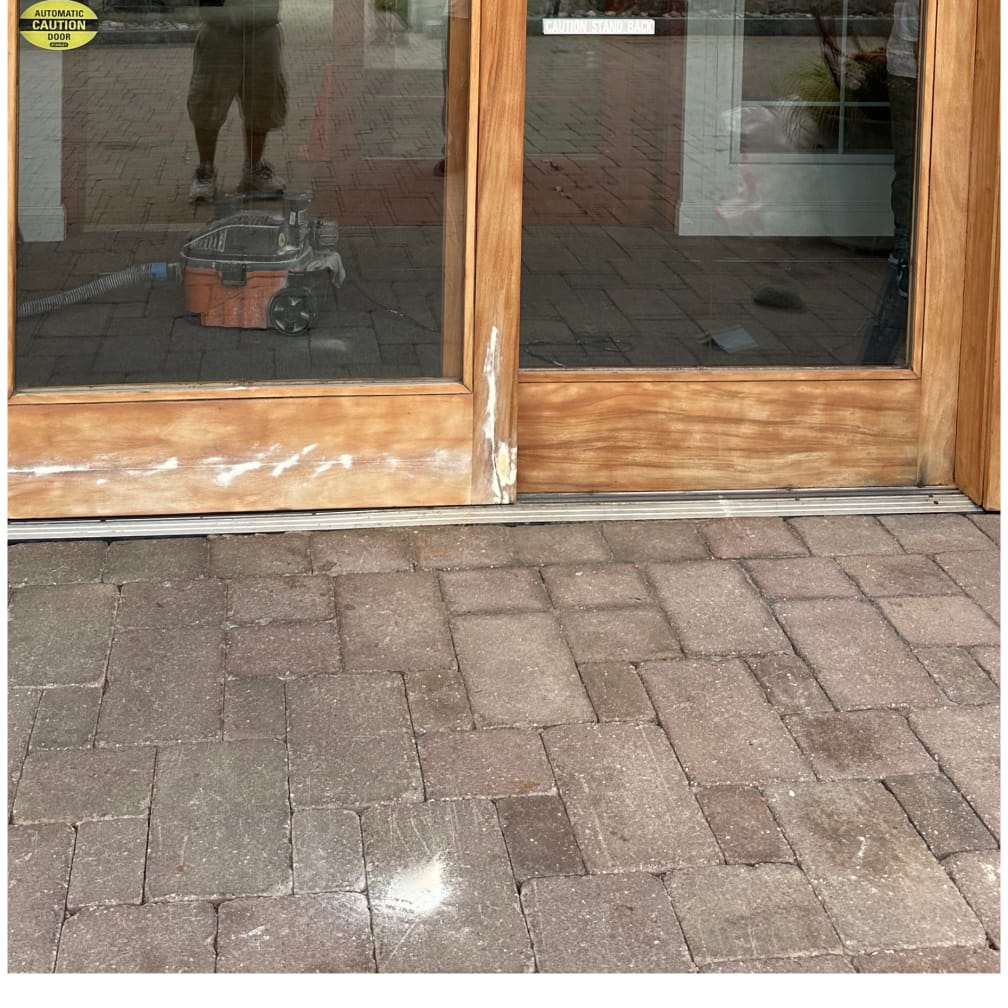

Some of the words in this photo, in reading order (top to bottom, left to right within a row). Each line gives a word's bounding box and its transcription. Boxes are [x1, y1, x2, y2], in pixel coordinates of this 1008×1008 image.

[34, 9, 84, 18] AUTOMATIC
[32, 20, 86, 30] CAUTION
[545, 21, 588, 33] CAUTION
[591, 21, 624, 33] STAND
[627, 21, 654, 33] BACK
[47, 33, 71, 41] DOOR
